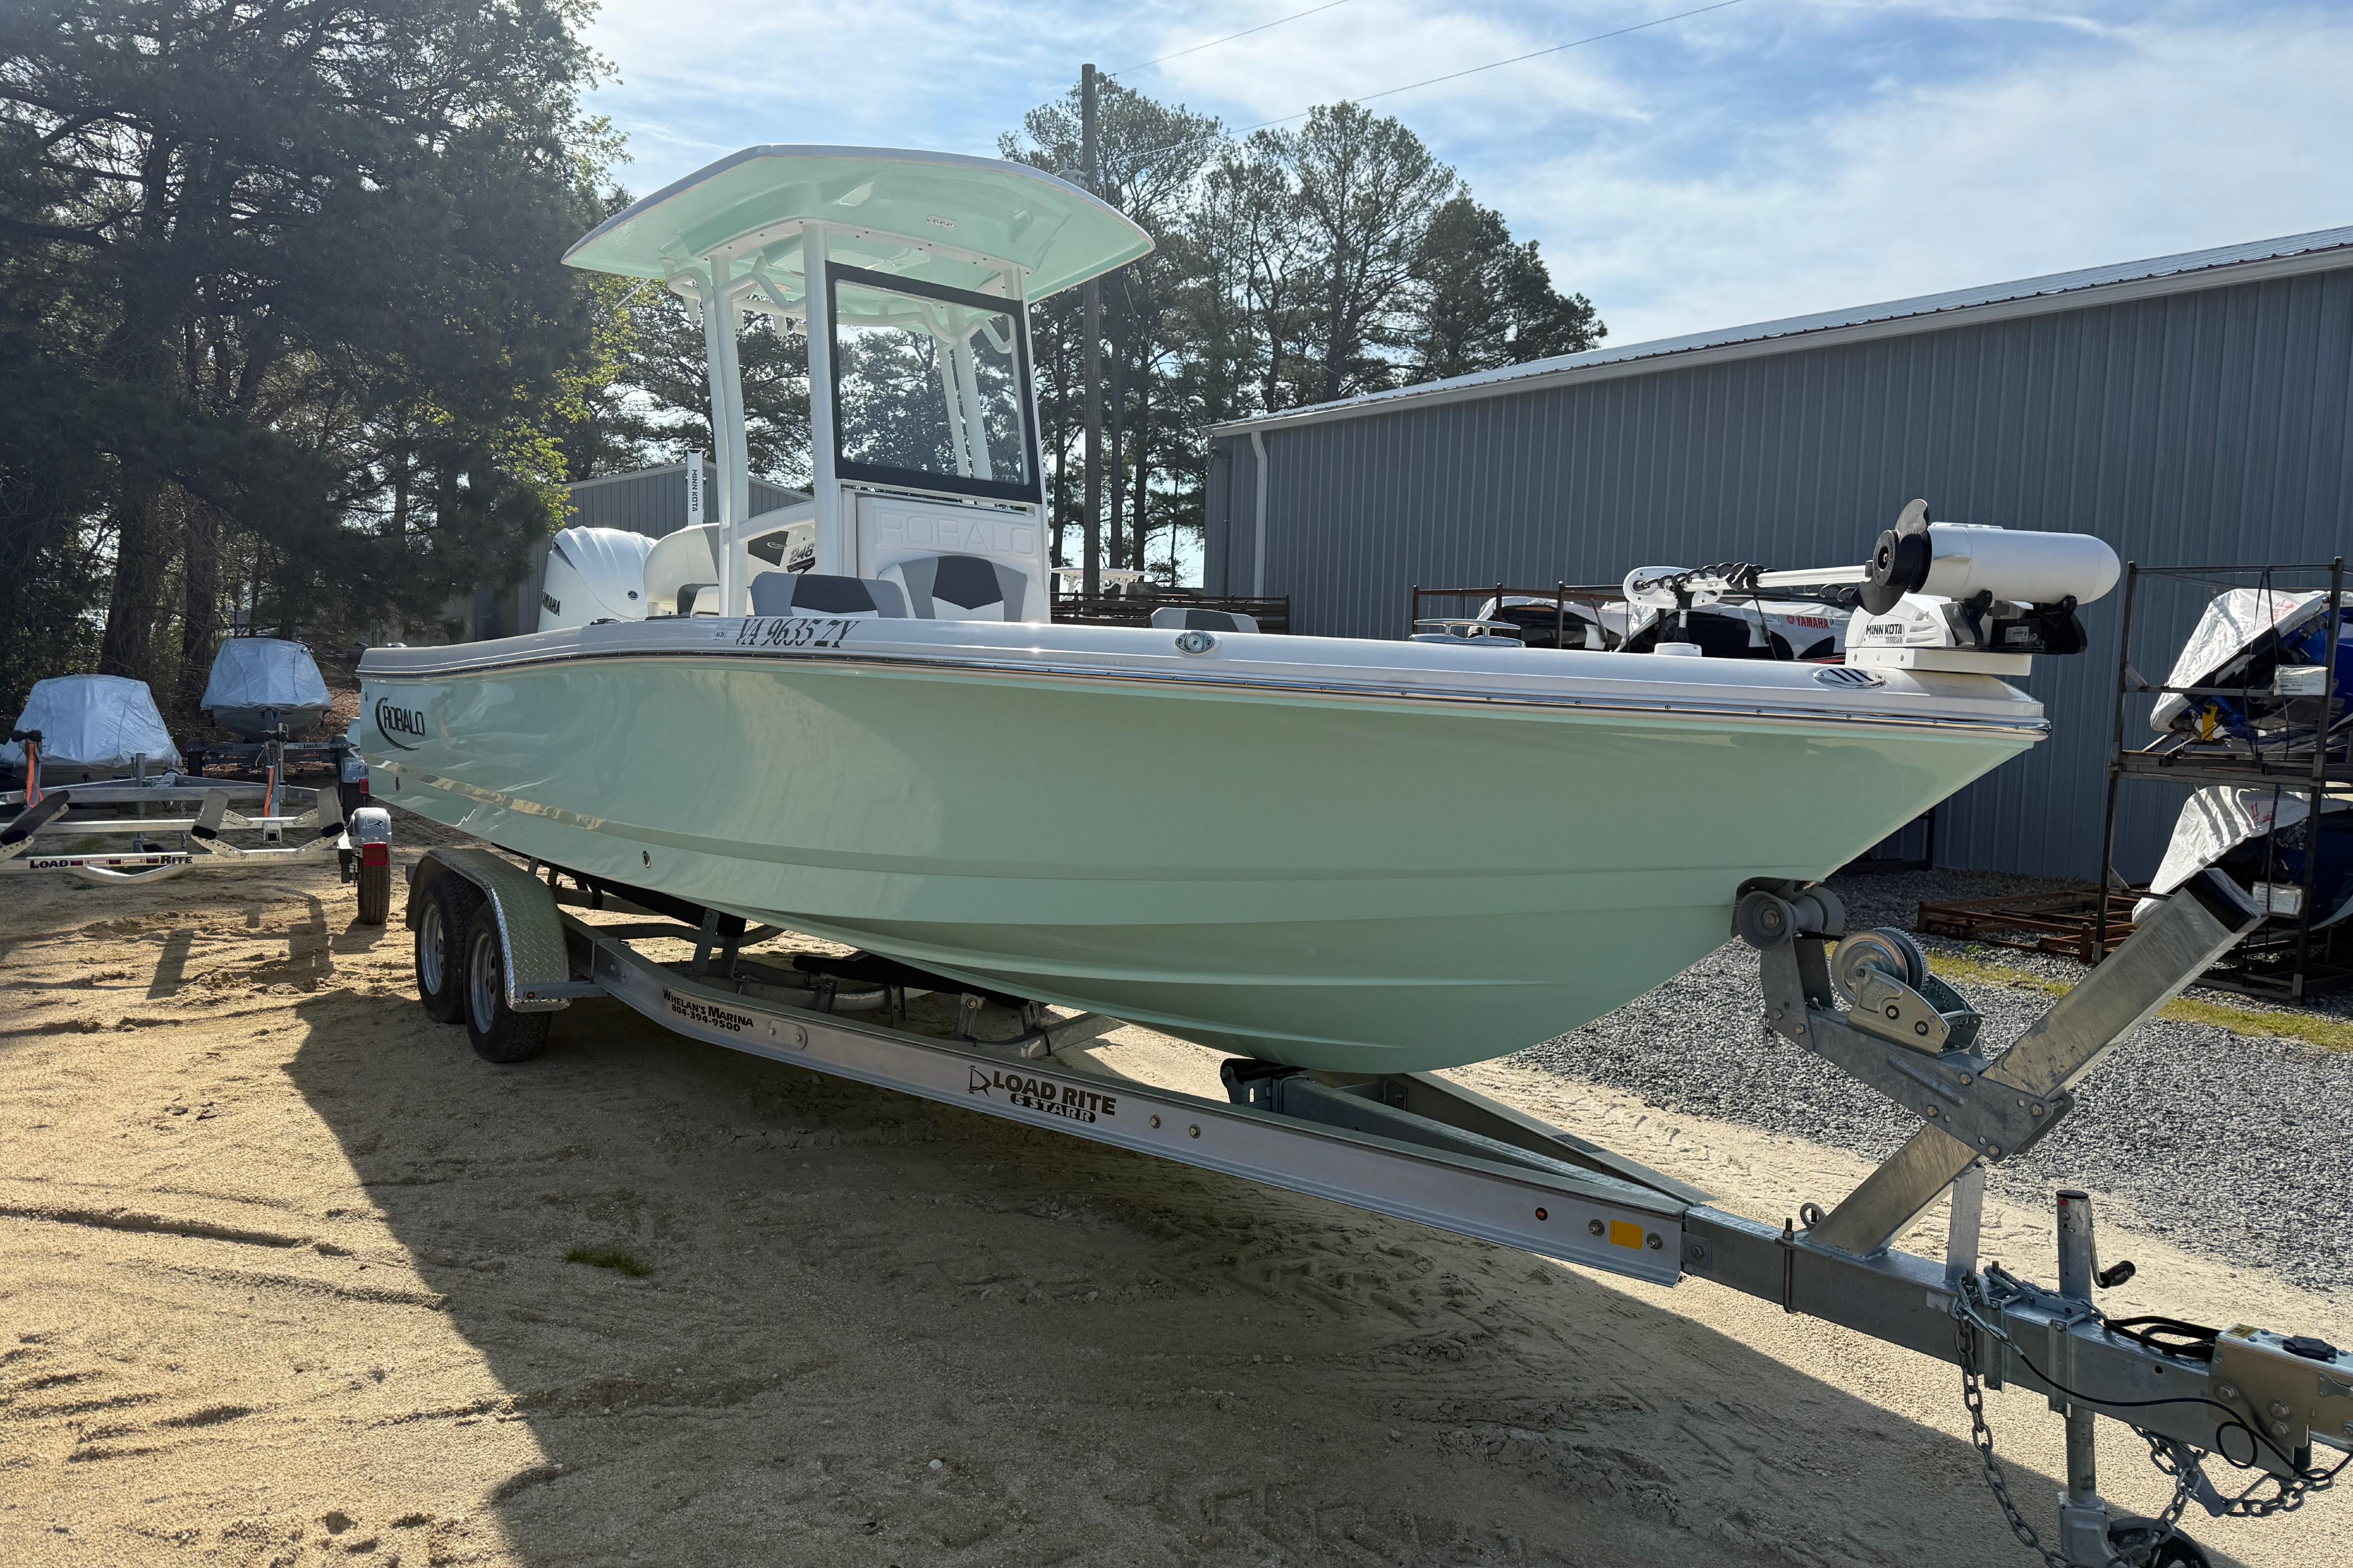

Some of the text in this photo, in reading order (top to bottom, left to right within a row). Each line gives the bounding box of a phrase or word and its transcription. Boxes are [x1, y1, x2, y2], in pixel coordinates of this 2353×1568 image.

[879, 512, 1034, 555] ROBALO
[789, 543, 815, 564] 246
[736, 618, 861, 648] VA 9635 ZY
[1795, 615, 1829, 629] YAMAHA
[1866, 623, 1902, 635] MINN KOTA
[383, 705, 425, 737] ROBALO
[29, 855, 193, 869] LOAD RITE
[663, 988, 754, 1028] WHELAN'S MARINA
[672, 1004, 740, 1032] 804-394-9500
[993, 1070, 1117, 1116] LOAD RITE
[1015, 1094, 1091, 1122] 5 STARR
